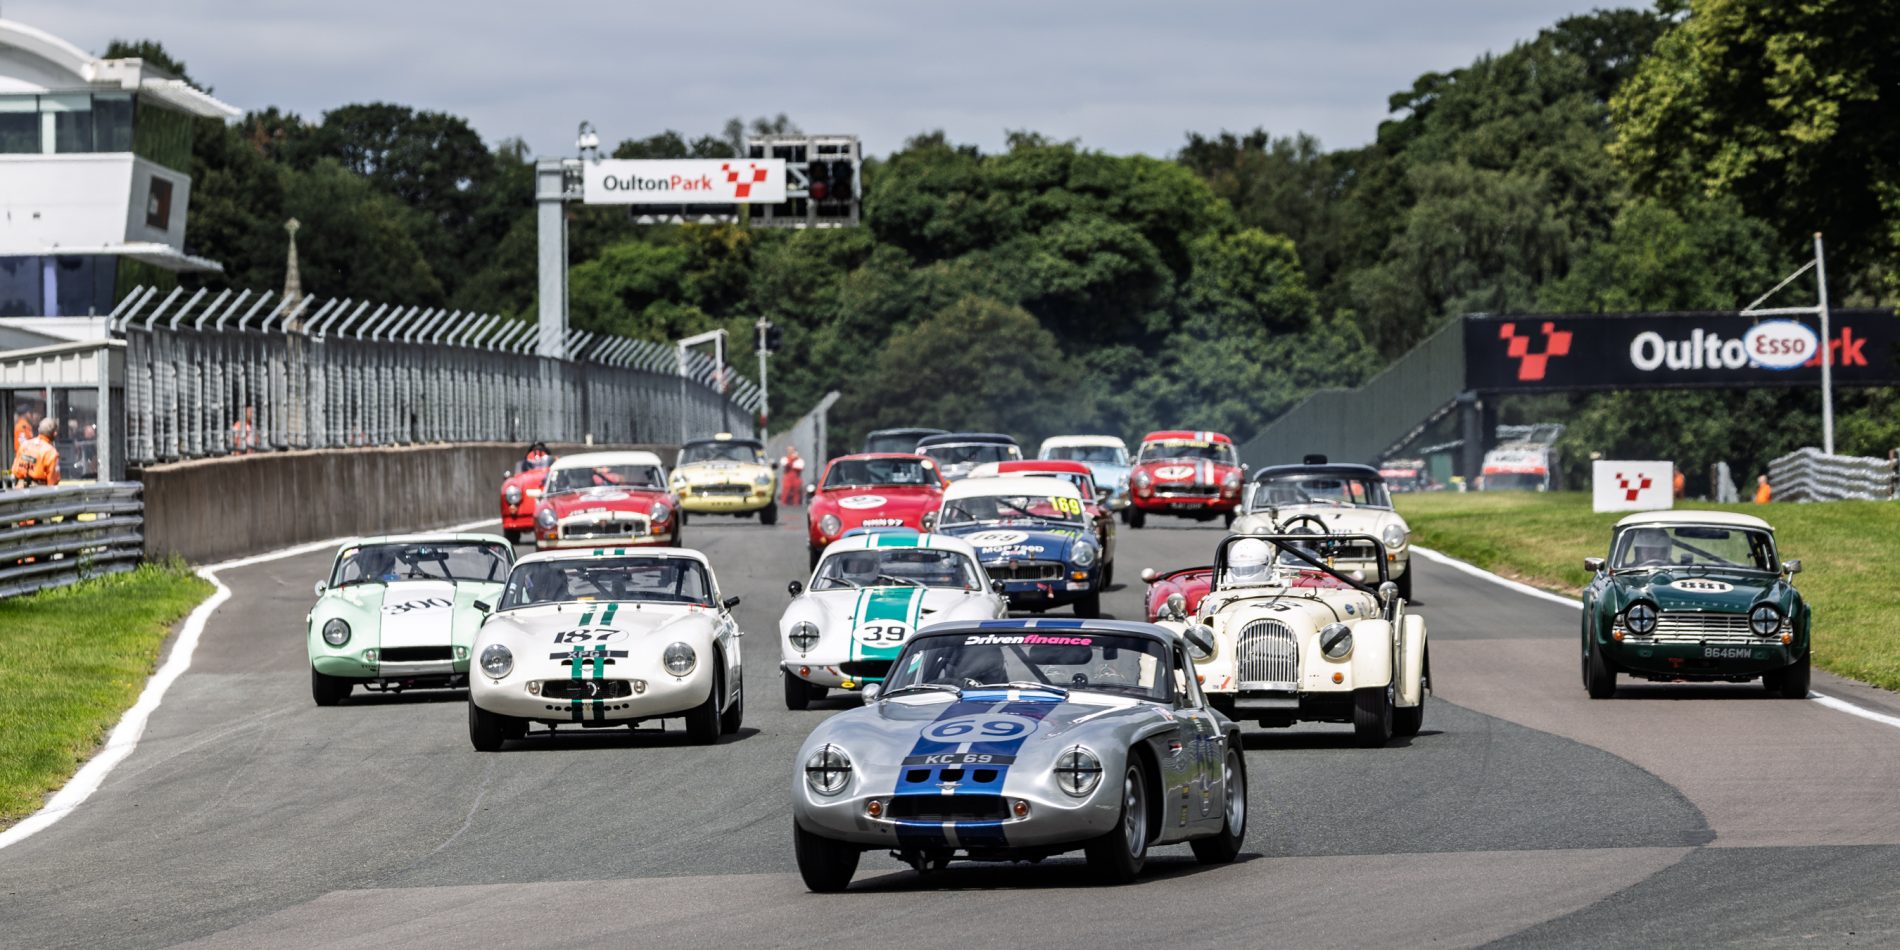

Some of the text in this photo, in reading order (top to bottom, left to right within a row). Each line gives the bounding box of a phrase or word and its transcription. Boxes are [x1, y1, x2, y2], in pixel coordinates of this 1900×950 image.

[603, 174, 712, 190] OultonPark
[1756, 335, 1806, 355] Esso
[1047, 496, 1080, 515] 169
[383, 598, 452, 615] 300
[554, 629, 621, 643] 187
[863, 626, 906, 641] 39
[1704, 648, 1752, 658] 8646MW
[931, 720, 1025, 738] 69
[925, 755, 993, 764] KC 69
